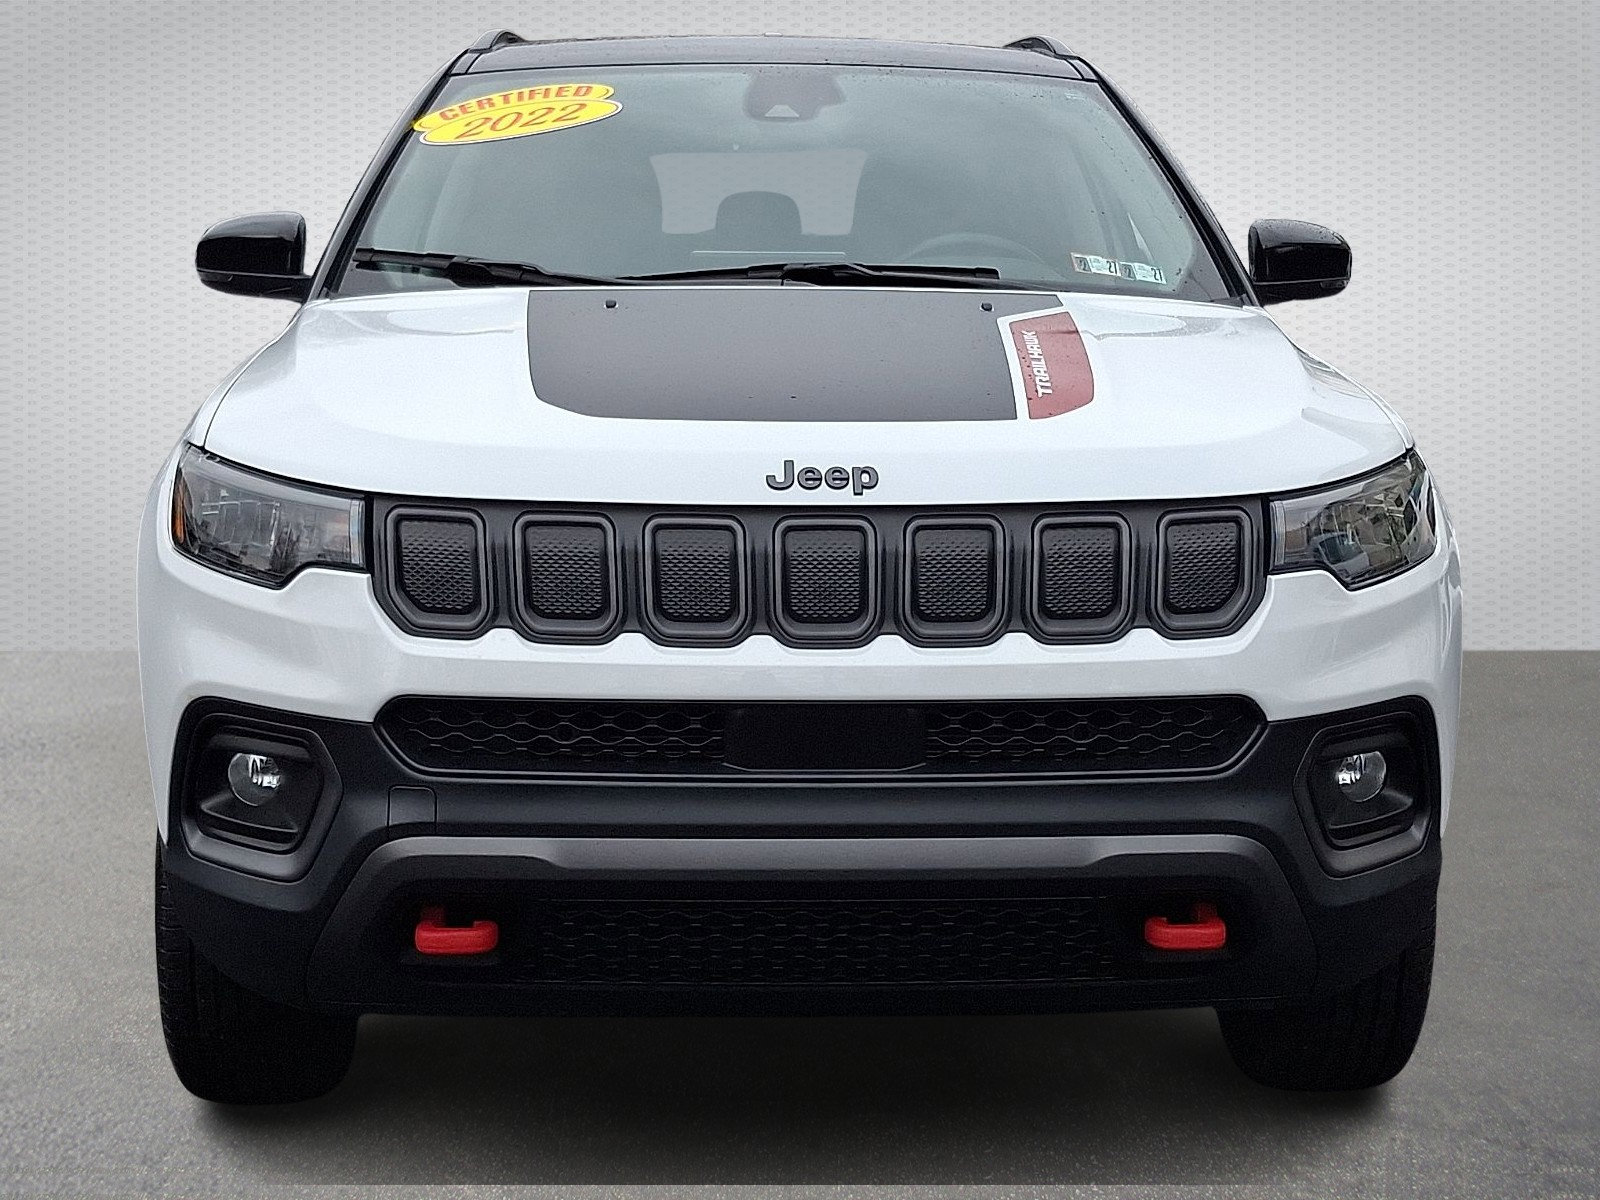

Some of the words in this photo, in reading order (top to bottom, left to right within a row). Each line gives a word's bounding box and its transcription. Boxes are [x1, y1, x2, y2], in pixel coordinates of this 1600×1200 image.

[439, 85, 593, 121] CERTIFIED
[455, 103, 587, 140] 2022
[1021, 330, 1053, 398] TRAILHAWK
[766, 459, 879, 496] Jeep
